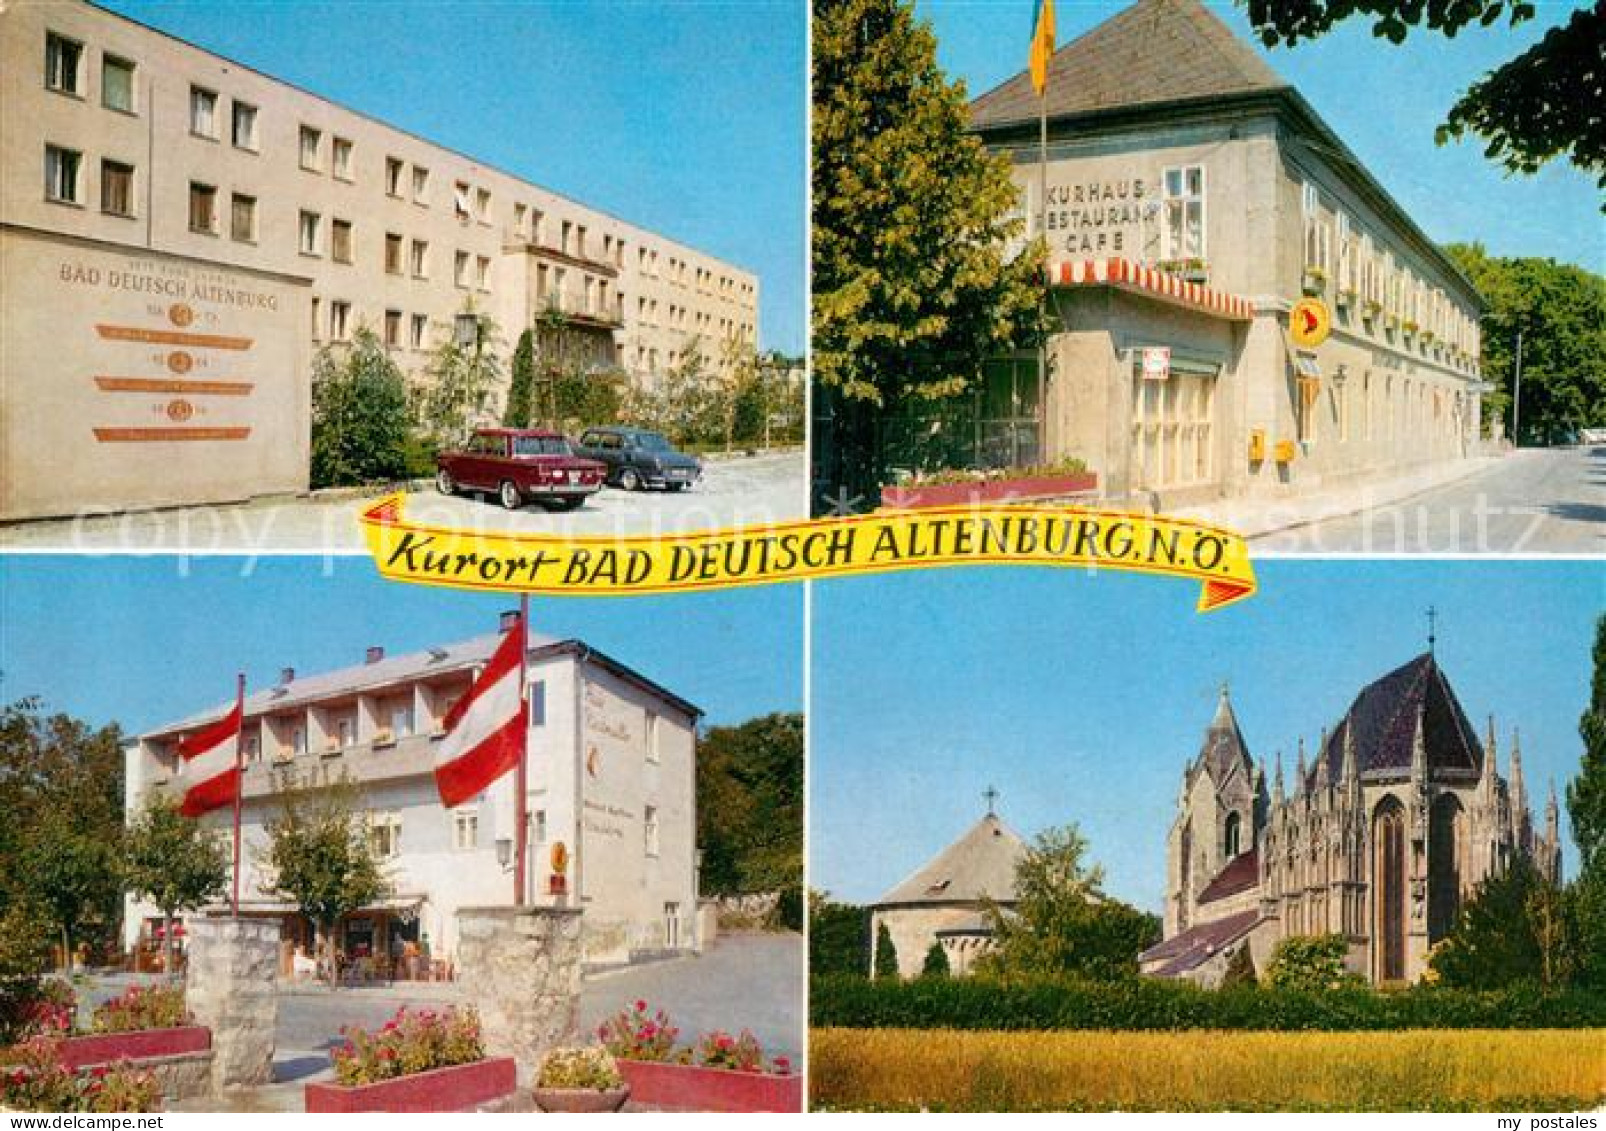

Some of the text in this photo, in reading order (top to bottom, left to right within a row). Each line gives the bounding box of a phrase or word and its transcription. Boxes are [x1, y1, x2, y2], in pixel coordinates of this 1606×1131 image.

[1046, 178, 1144, 205] KURHAUS
[1035, 204, 1156, 231] ESTAURAN
[59, 263, 100, 286] BAD
[108, 270, 187, 299] DEUTSCH
[191, 285, 278, 311] ALTENBURG
[387, 533, 561, 581] Kurort
[561, 550, 652, 584] BAD
[669, 528, 856, 582] DEUTSCH
